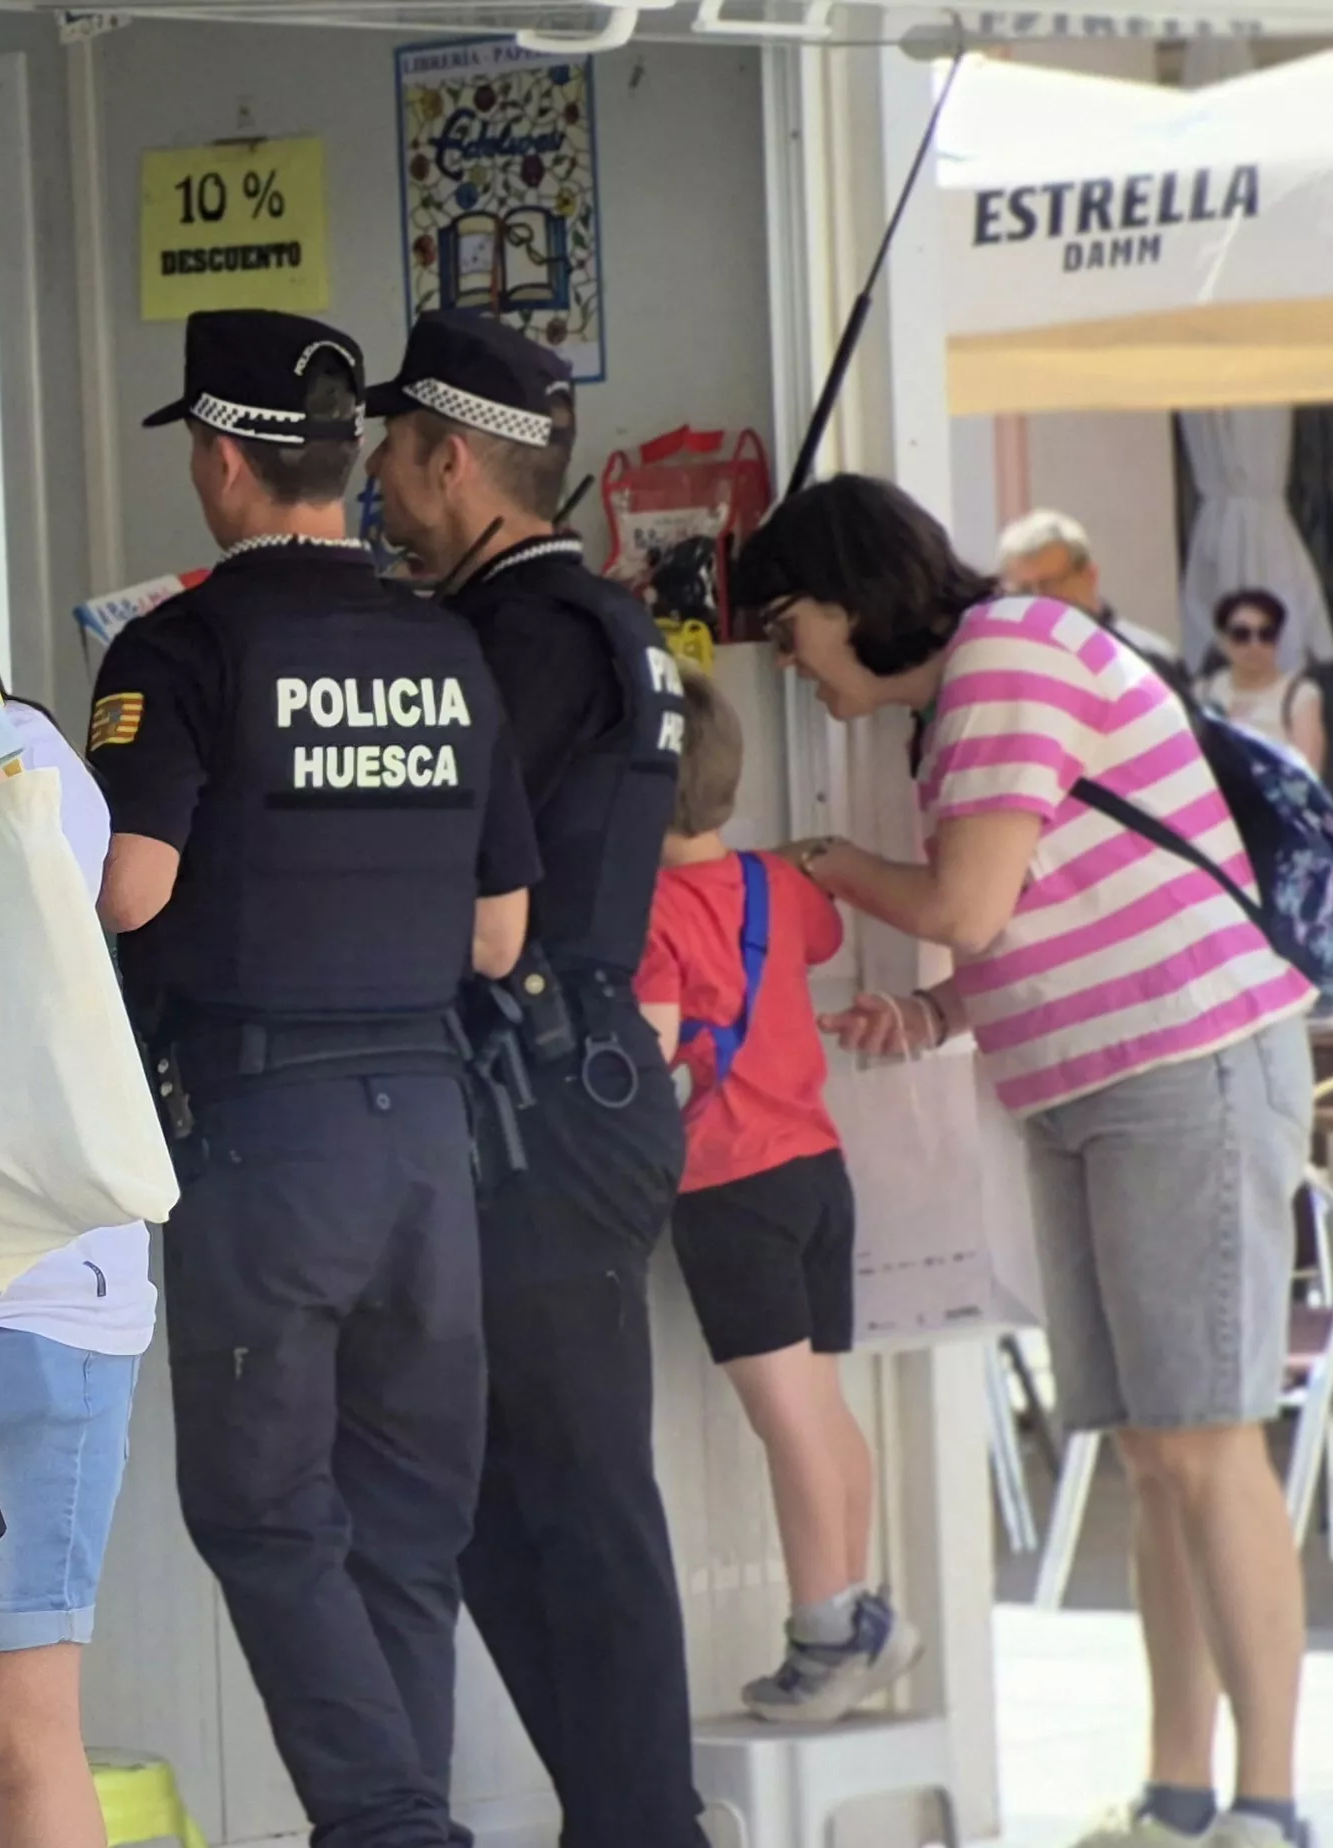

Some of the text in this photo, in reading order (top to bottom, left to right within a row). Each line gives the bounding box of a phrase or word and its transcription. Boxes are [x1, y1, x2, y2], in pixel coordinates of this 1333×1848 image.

[175, 169, 286, 224] 10 %
[972, 163, 1259, 247] ESTRELLA
[161, 240, 302, 276] DESCUENTO
[1062, 233, 1161, 272] DAMM
[277, 677, 471, 727] POLICIA
[293, 745, 458, 788] HUESCA
